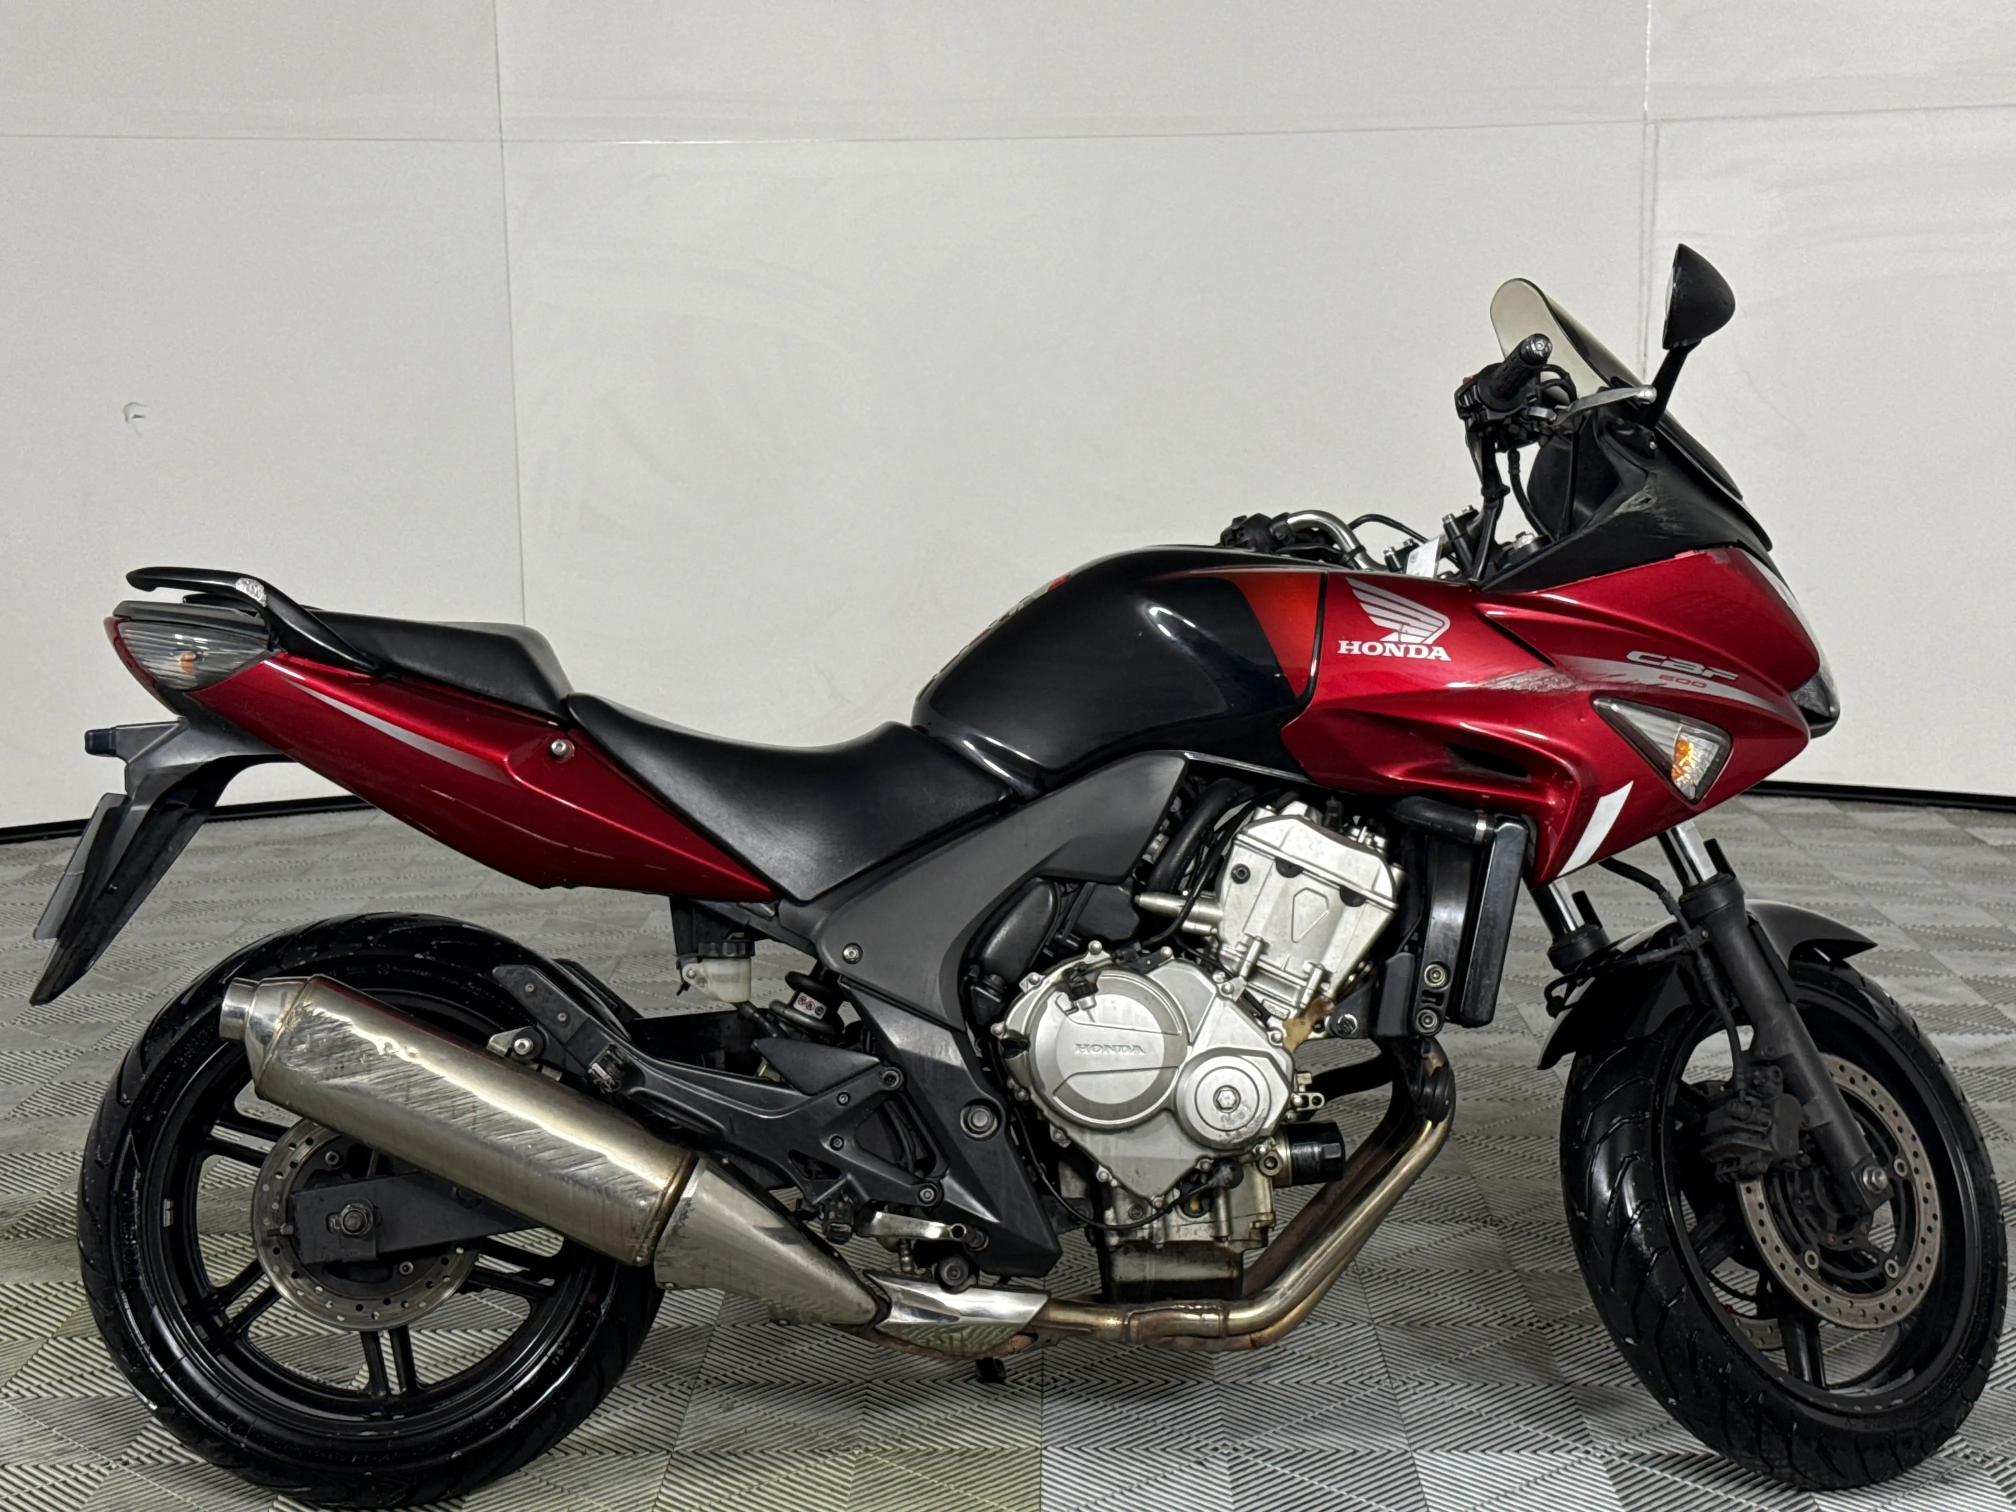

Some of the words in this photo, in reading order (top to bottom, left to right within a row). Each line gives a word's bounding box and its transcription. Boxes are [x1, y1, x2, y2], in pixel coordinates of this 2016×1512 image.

[1338, 640, 1451, 661] HONDA
[1626, 650, 1739, 680] CBF
[1074, 1043, 1146, 1055] HONDA
